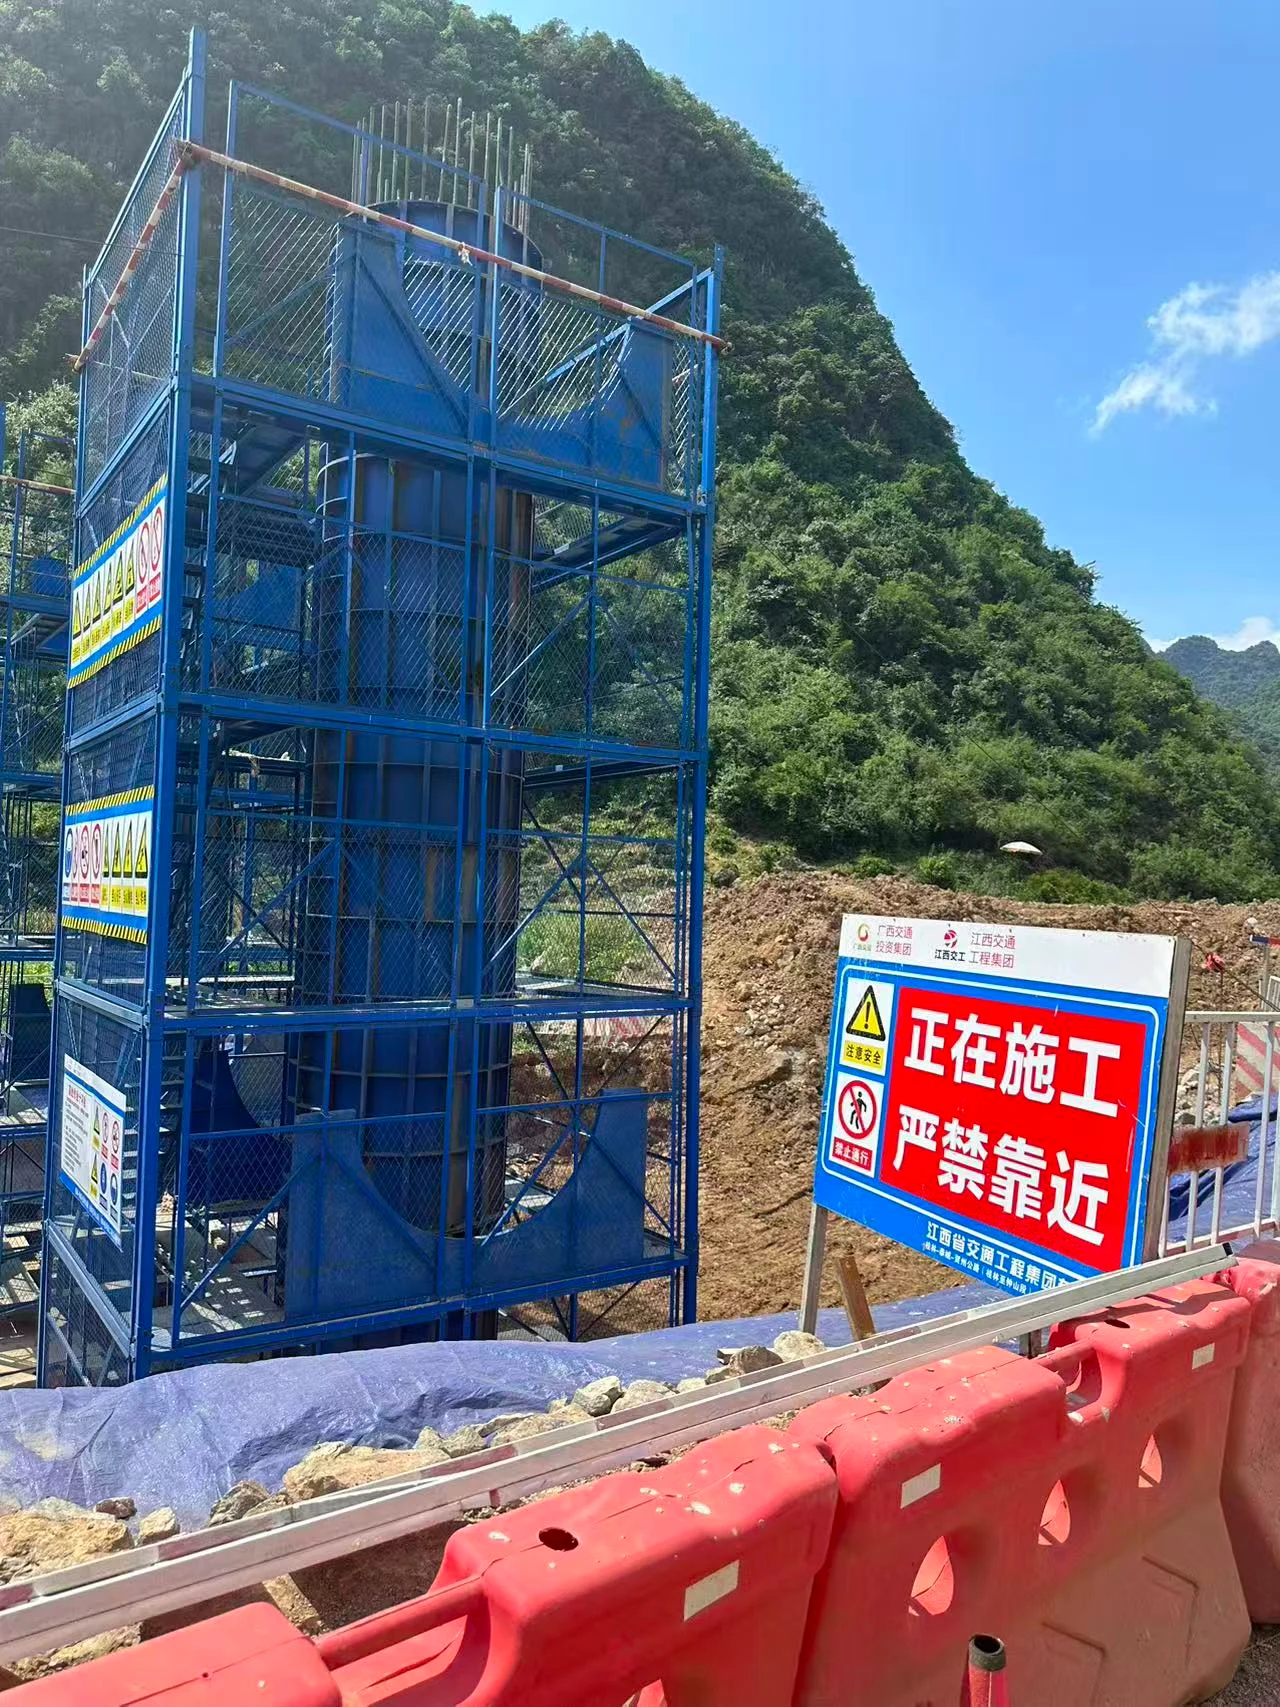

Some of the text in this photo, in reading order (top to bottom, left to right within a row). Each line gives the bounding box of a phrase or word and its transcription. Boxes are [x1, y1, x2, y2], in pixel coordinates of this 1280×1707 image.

[876, 924, 913, 940] 广西交通
[970, 931, 1016, 949] 江西交通
[875, 940, 912, 956] 投资集团
[934, 949, 966, 962] 江西交工
[968, 951, 1015, 969] 工程集团
[845, 1044, 882, 1066] 注意安全
[903, 1006, 1122, 1118] 正在施工
[833, 1140, 870, 1167] 禁止通行
[892, 1104, 1109, 1245] 严禁靠近
